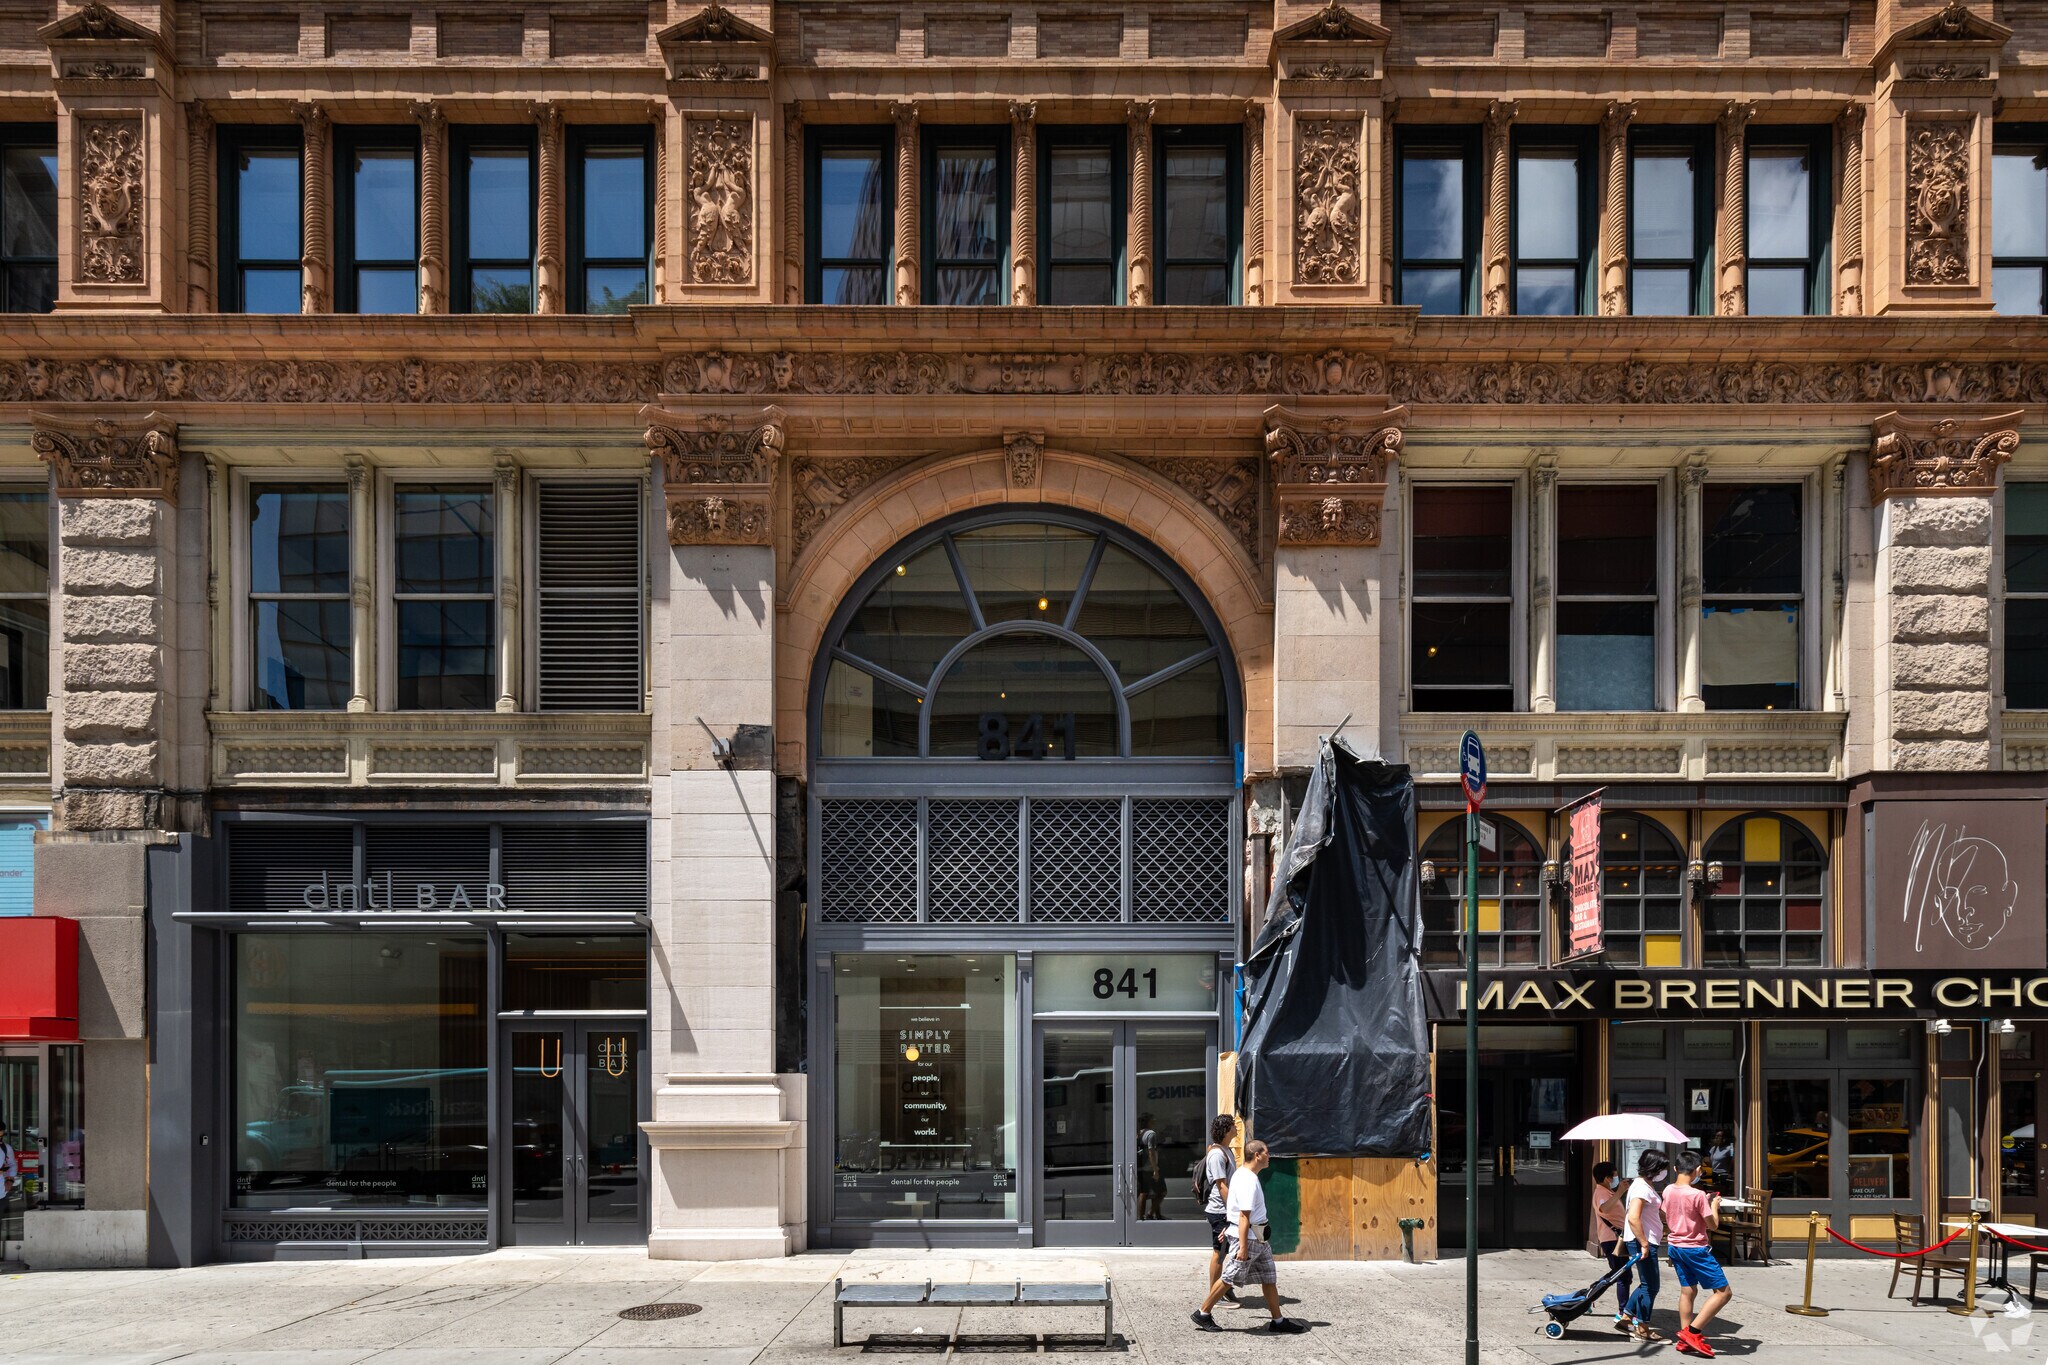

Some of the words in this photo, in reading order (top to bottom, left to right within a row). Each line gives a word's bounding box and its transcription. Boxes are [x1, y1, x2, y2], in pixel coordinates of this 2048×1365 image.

[1001, 364, 1046, 385] 841
[977, 711, 1076, 760] 841
[1575, 860, 1596, 887] MAX
[303, 870, 394, 910] dntl
[416, 883, 507, 910] BAR
[1093, 968, 1156, 999] 841
[1457, 979, 1596, 1010] MAX
[1614, 979, 1916, 1010] BRENNER
[899, 1029, 951, 1040] SIMPLY
[912, 1074, 940, 1083] people,
[904, 1102, 947, 1111] community,
[1694, 1091, 1707, 1105] A
[372, 1180, 397, 1189] people
[936, 1178, 960, 1187] people
